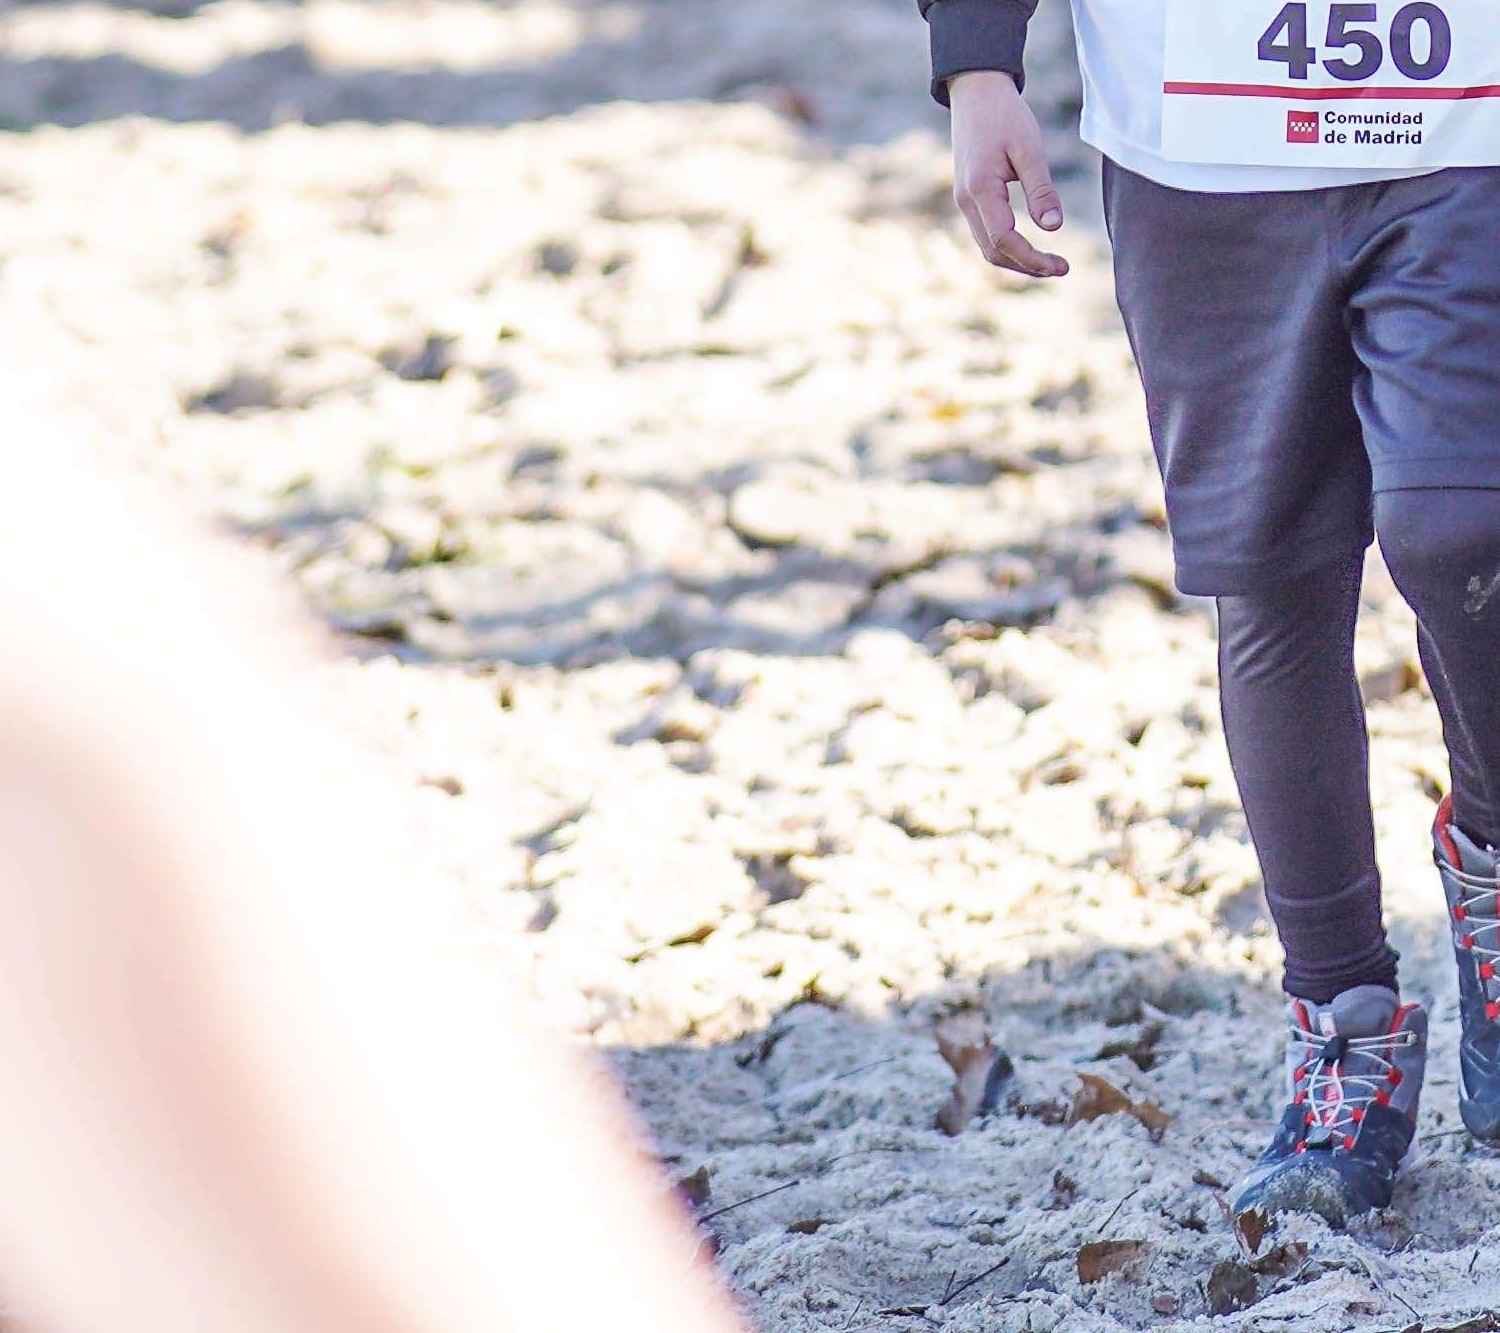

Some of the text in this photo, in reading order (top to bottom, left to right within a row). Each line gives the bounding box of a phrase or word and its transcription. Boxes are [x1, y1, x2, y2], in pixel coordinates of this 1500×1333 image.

[1257, 1, 1451, 81] 450
[1324, 111, 1423, 124] Comunidad
[1324, 129, 1422, 144] de Madrid
